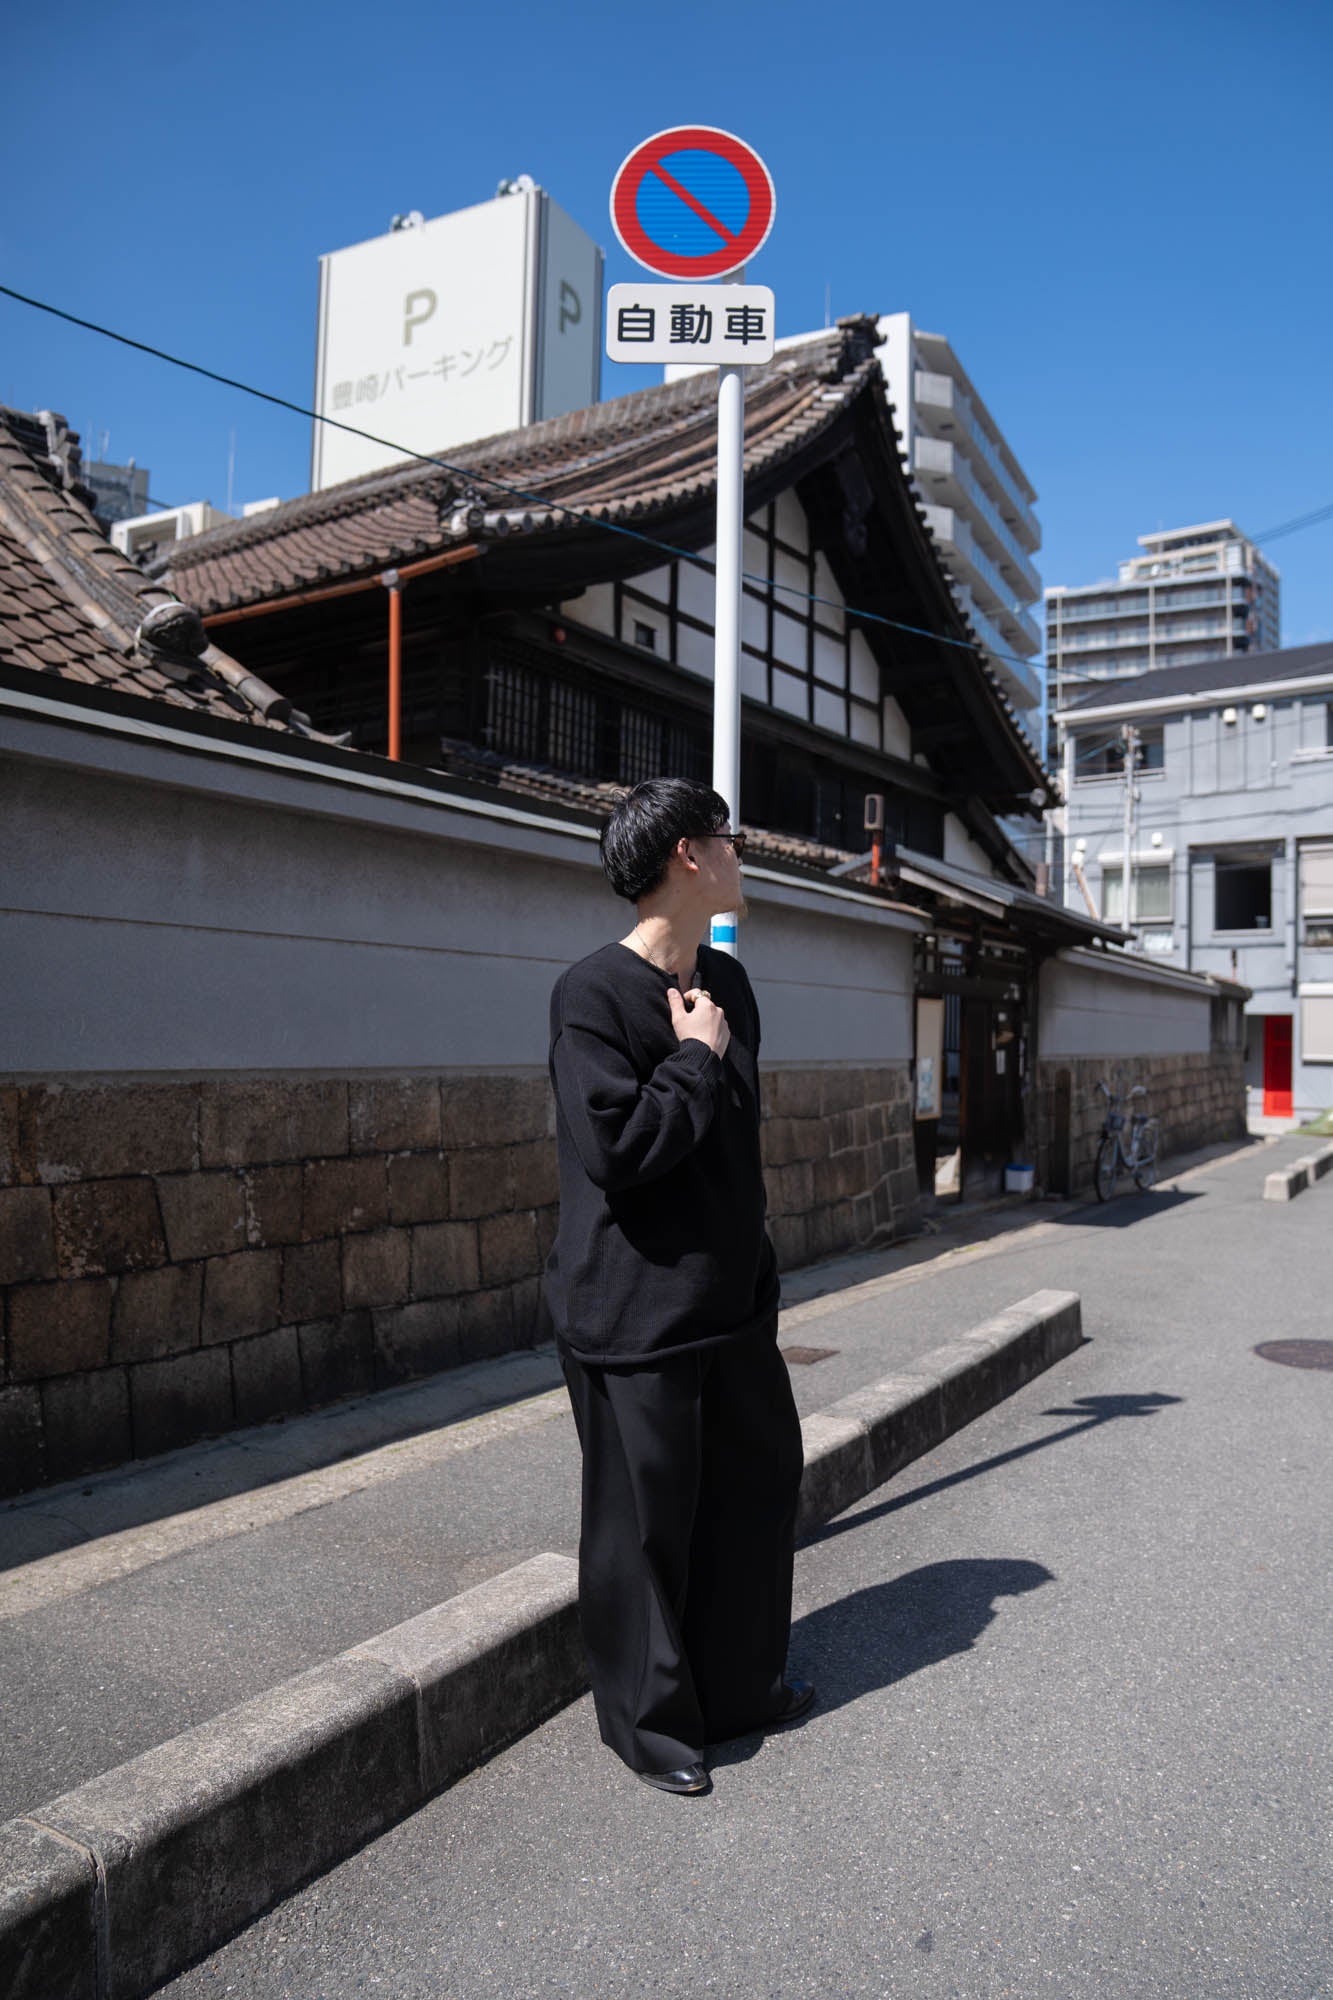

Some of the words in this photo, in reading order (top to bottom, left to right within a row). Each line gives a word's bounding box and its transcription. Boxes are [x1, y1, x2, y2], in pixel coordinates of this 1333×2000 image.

[403, 288, 438, 347] P
[559, 278, 581, 334] P
[617, 303, 767, 346] 自動車
